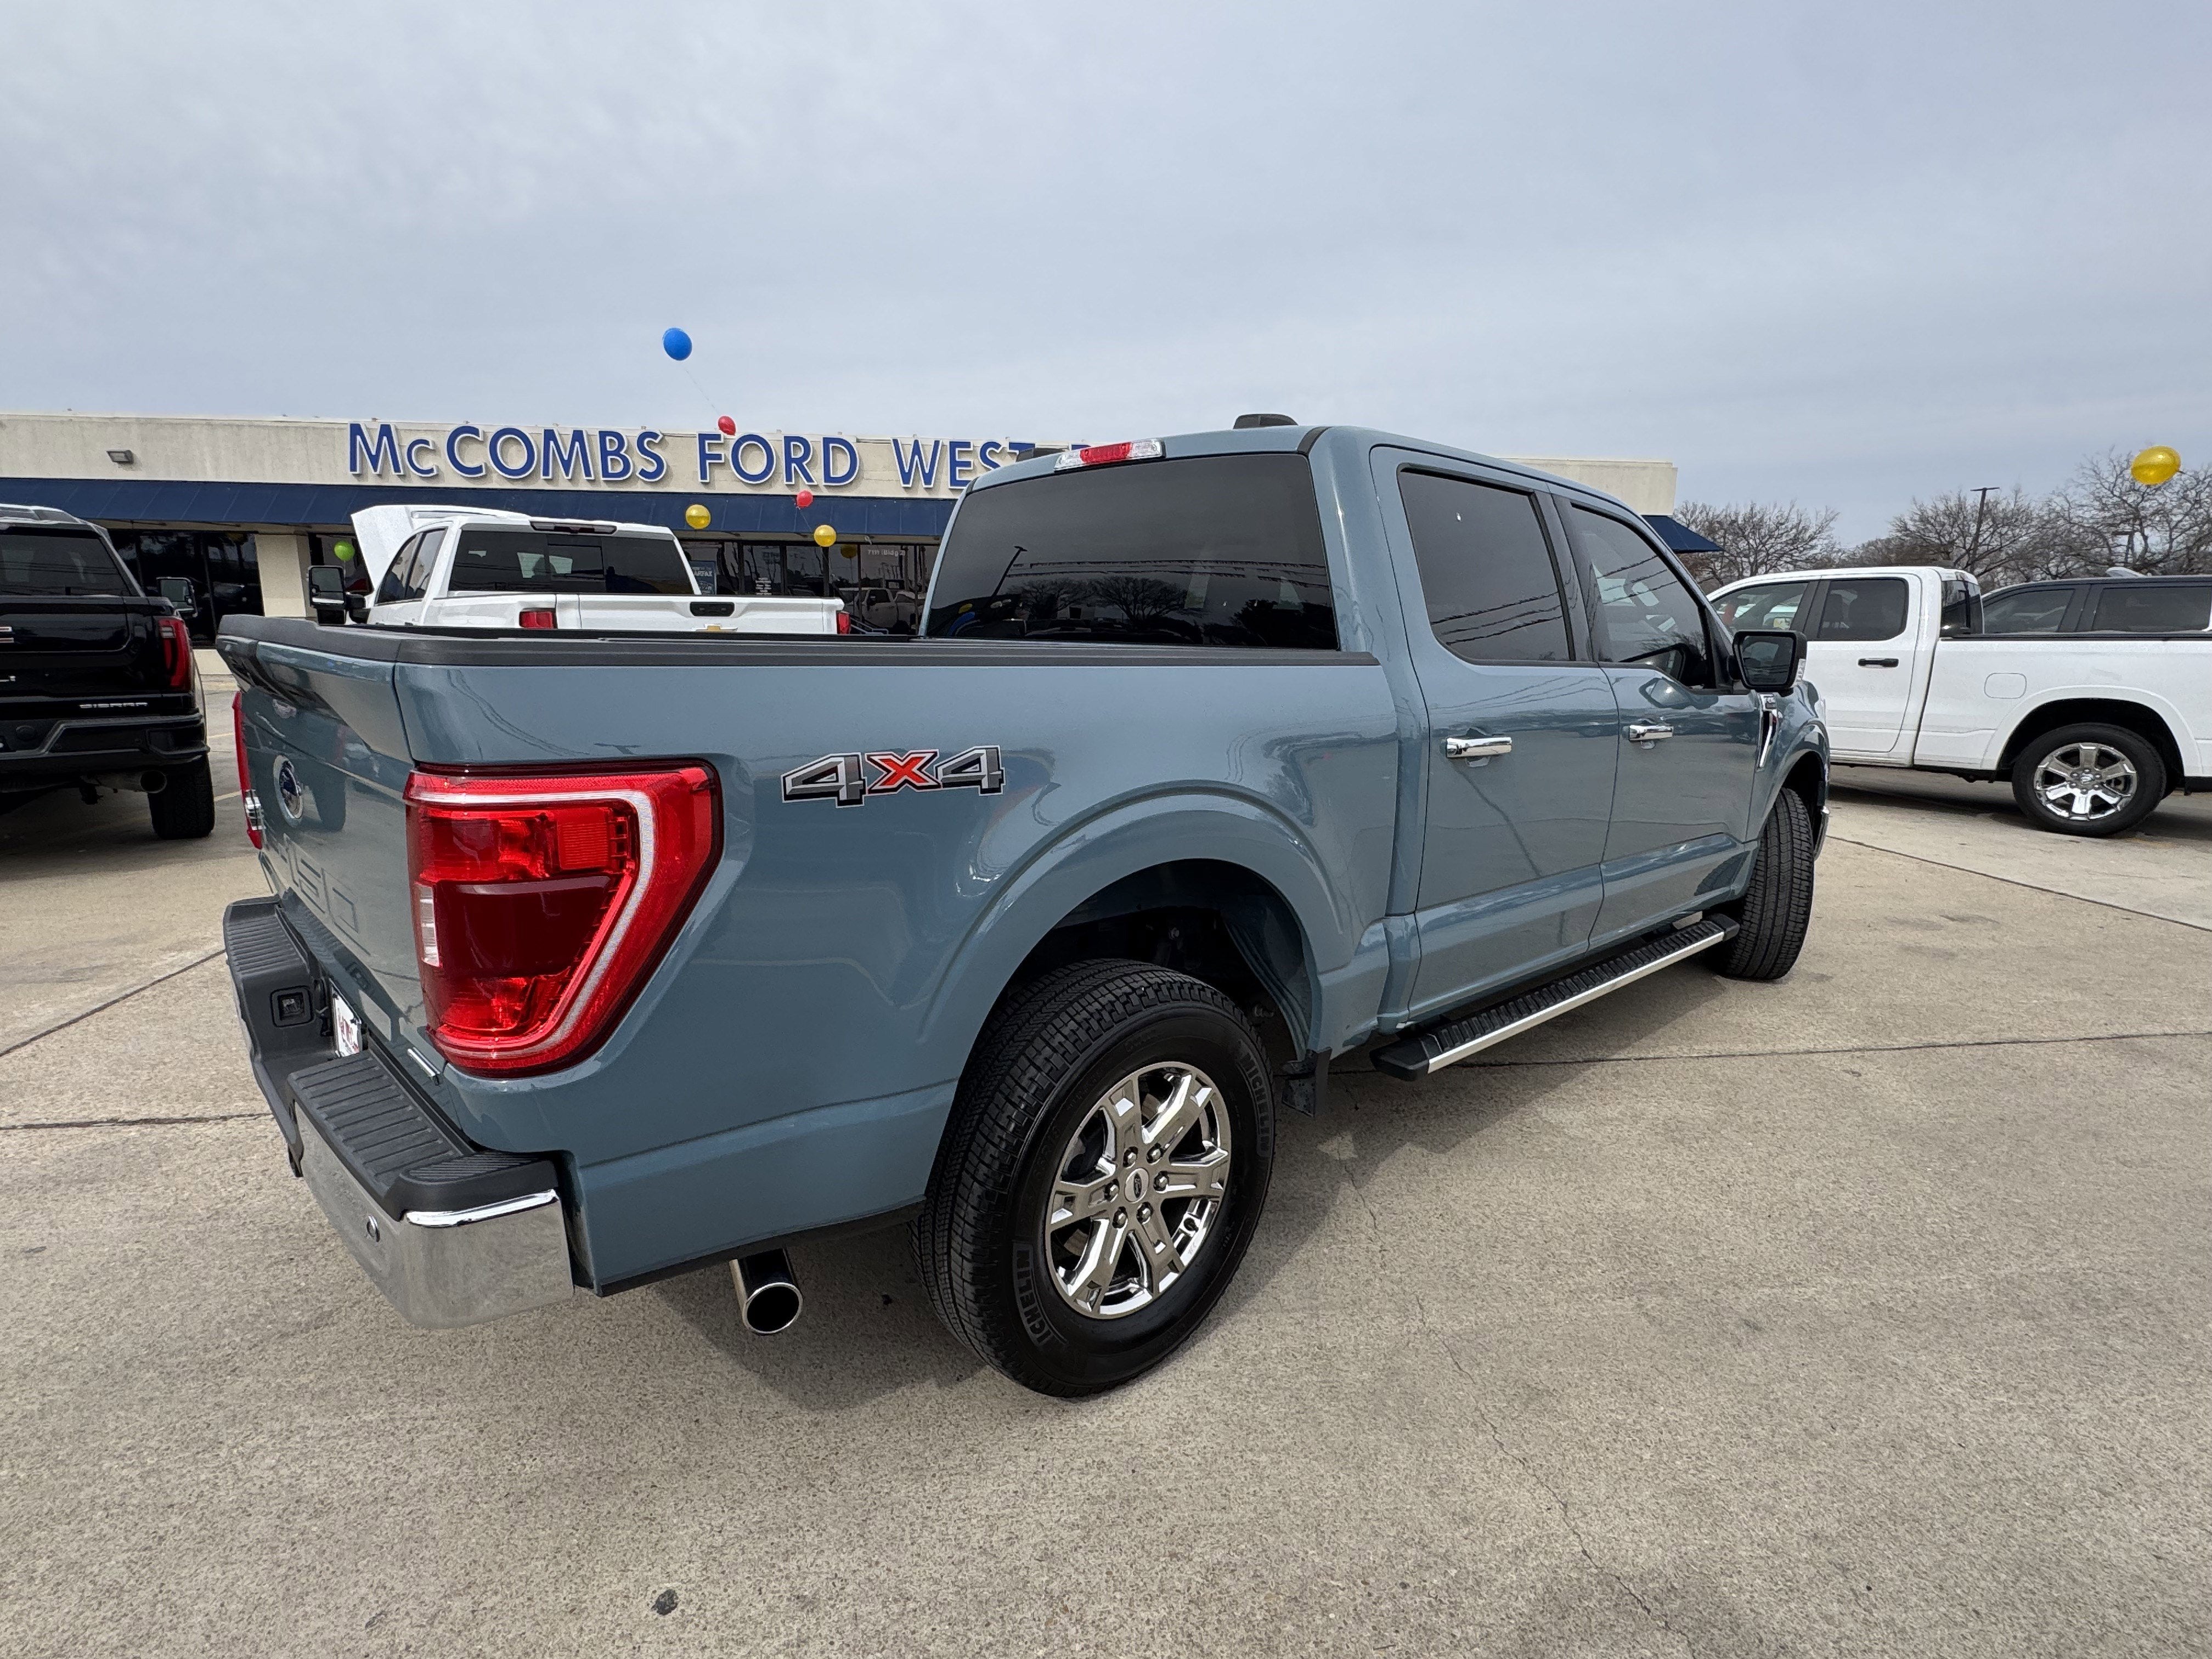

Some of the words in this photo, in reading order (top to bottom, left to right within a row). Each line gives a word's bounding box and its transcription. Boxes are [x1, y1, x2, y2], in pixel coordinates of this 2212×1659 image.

[348, 422, 667, 483] McCOMBS
[697, 432, 860, 486] FORD
[1015, 1249, 1054, 1346] ICHELIN
